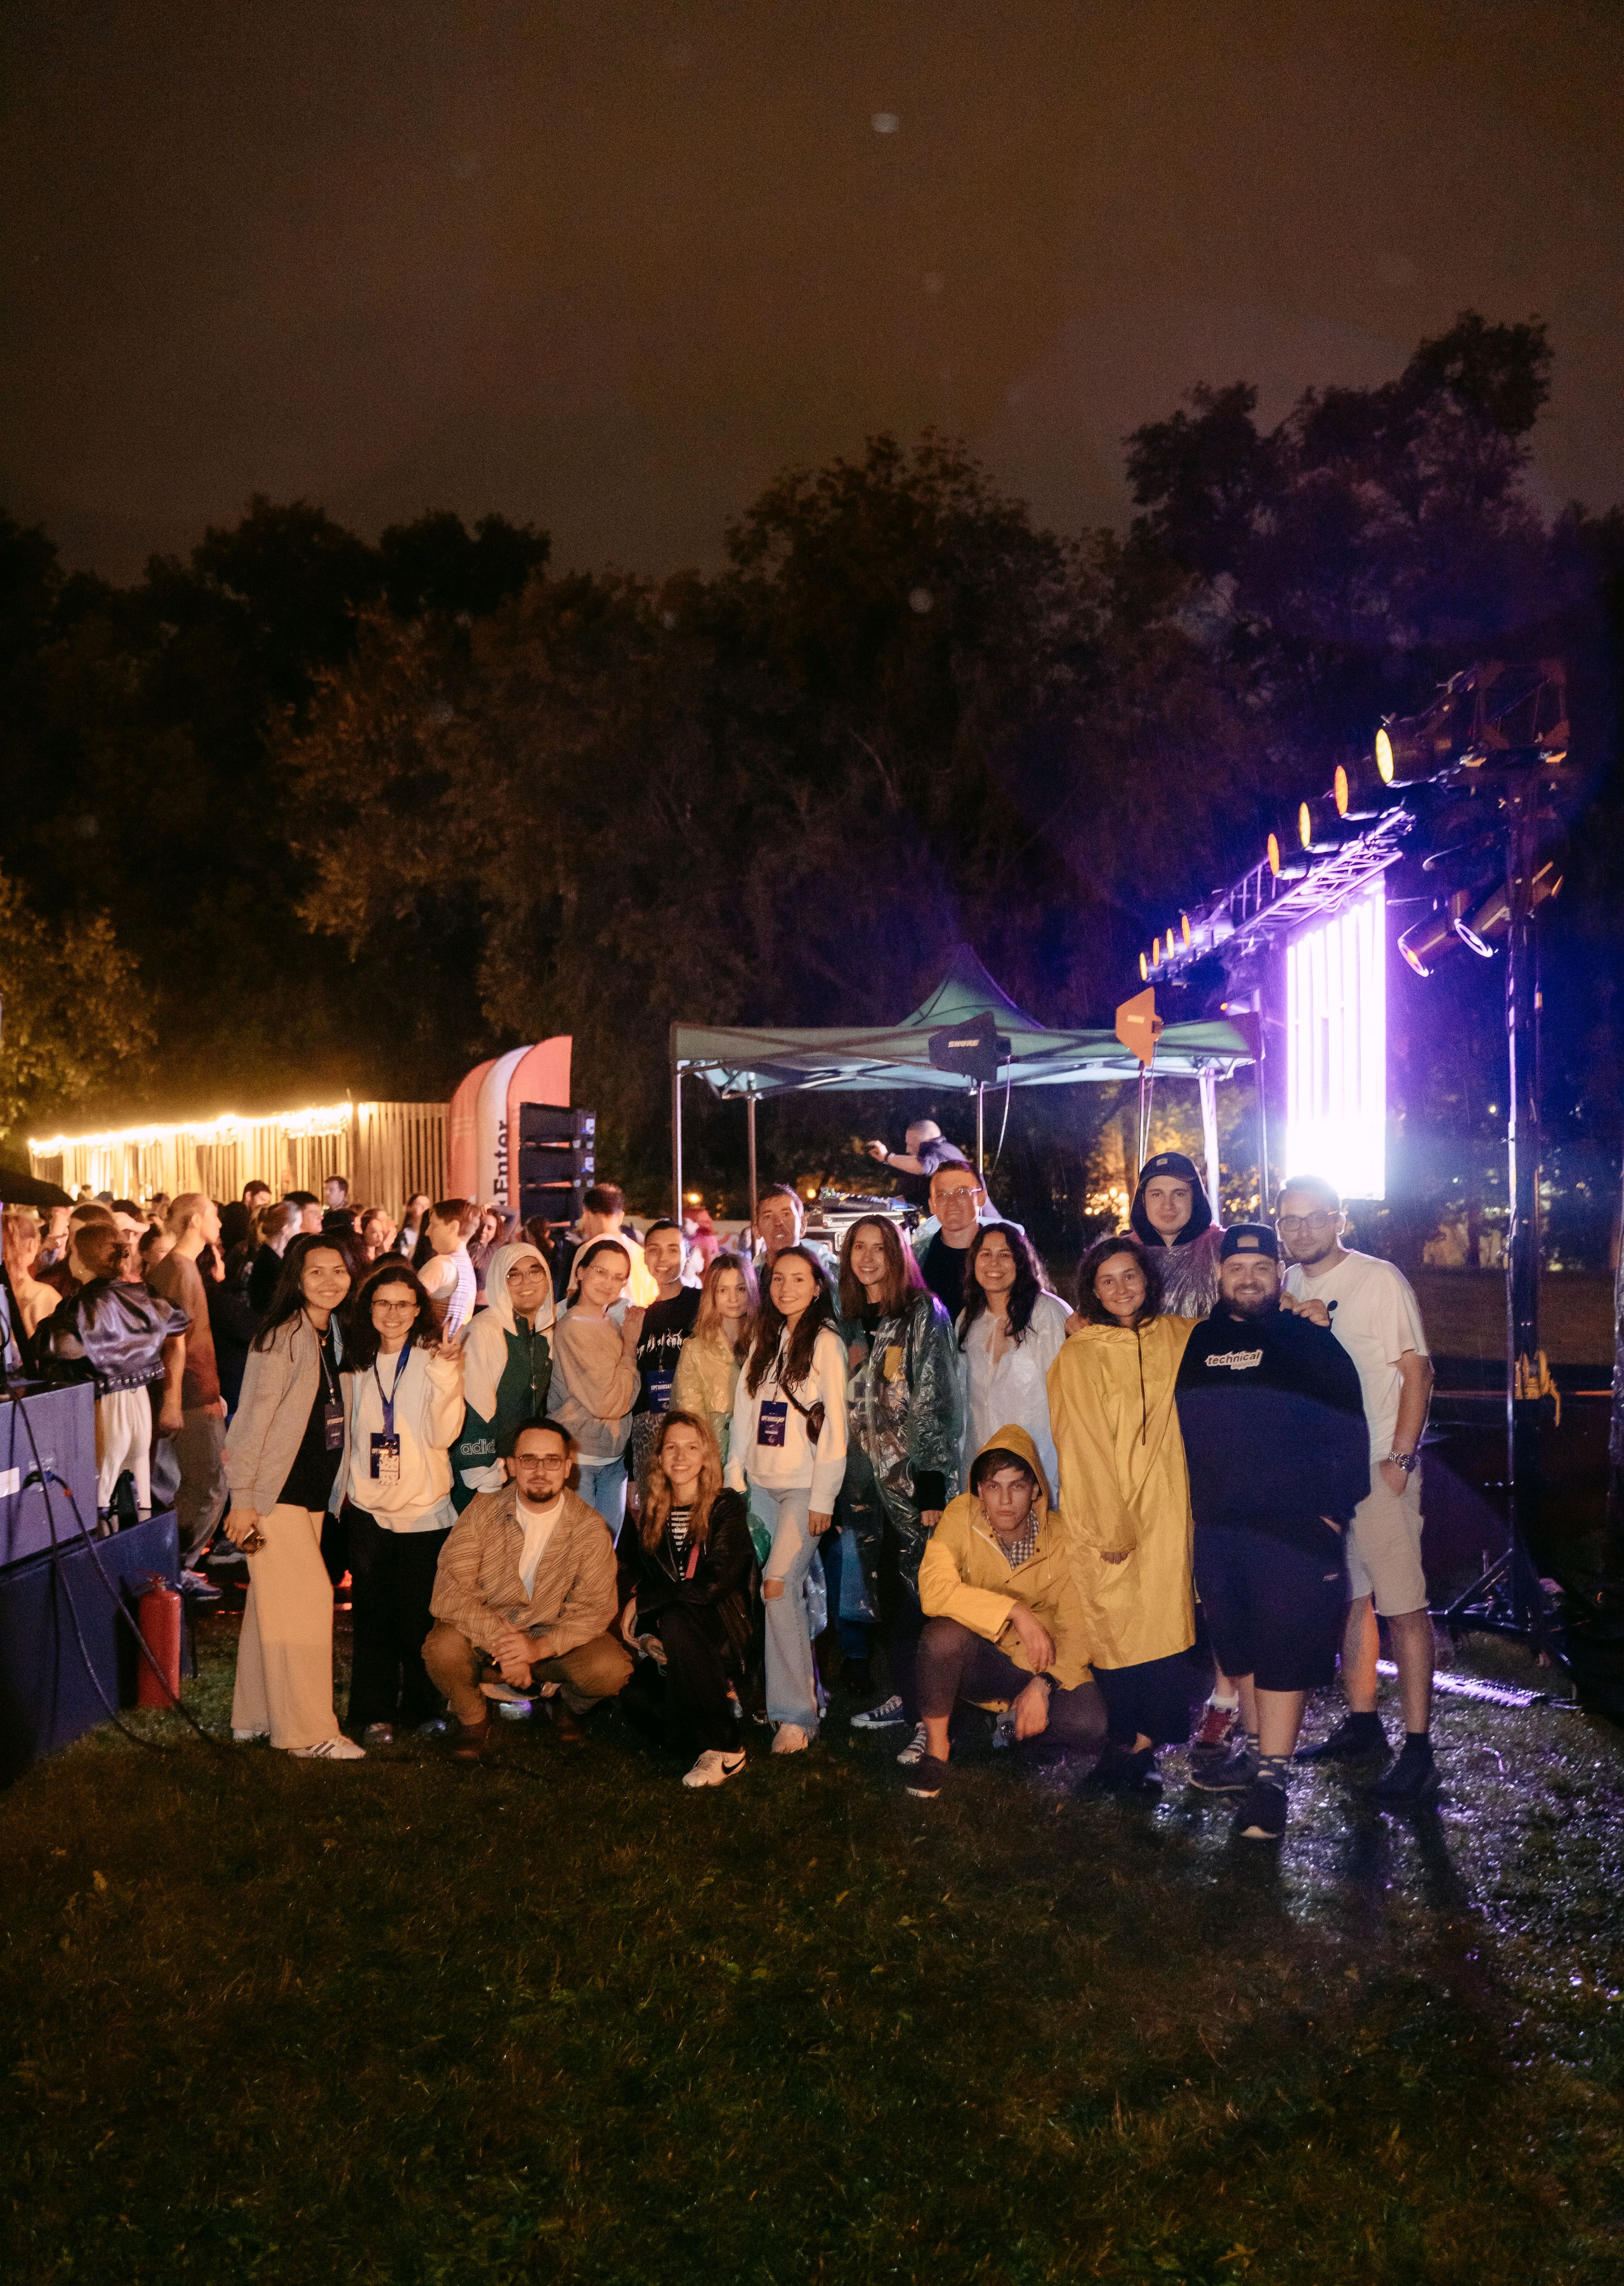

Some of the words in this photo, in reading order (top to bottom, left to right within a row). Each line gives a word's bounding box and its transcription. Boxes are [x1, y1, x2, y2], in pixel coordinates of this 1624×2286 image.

[948, 1039, 980, 1048] SHURE
[493, 1120, 508, 1196] Enter
[1208, 1351, 1260, 1365] technical
[1232, 1360, 1258, 1369] support
